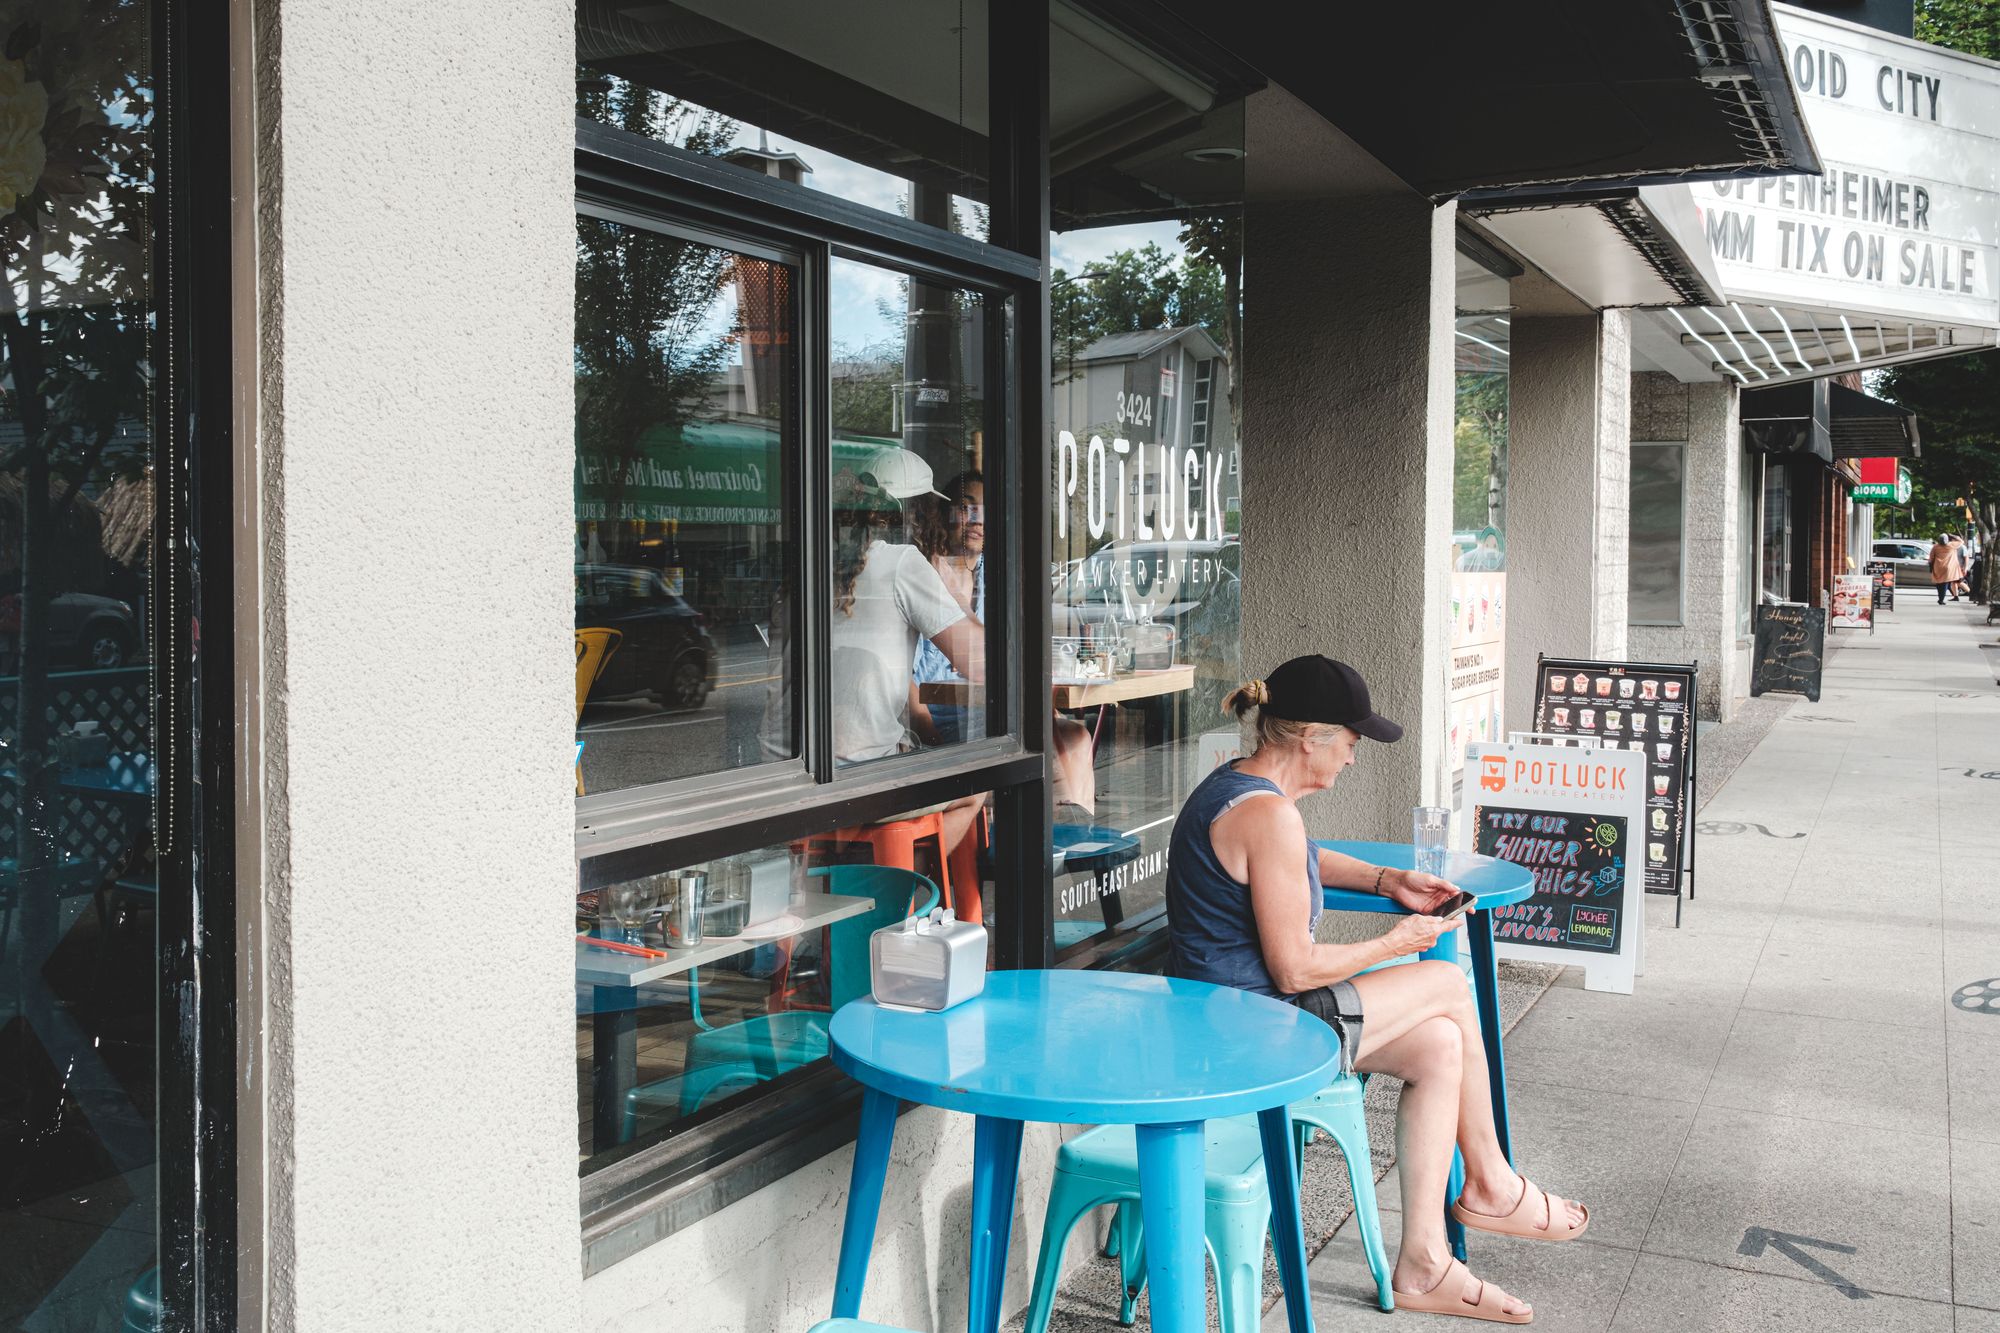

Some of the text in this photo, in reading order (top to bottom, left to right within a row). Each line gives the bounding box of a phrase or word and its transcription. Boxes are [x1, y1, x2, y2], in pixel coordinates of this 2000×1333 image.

[1784, 43, 1941, 121] OID CITY
[1777, 220, 1831, 274] TIX
[1843, 230, 1885, 282] ON
[1900, 239, 1975, 294] SALE
[1116, 391, 1152, 427] 3424
[1058, 430, 1223, 541] POTLUCK
[1853, 486, 1889, 495] SIOPAO
[1059, 559, 1223, 588] HAWKER EATERY
[1514, 760, 1627, 791] POTLUCK
[1514, 786, 1625, 801] HAWKER EATERY
[1488, 813, 1570, 835] TRY OUR
[1060, 864, 1128, 914] SOUTH-EAST
[1132, 850, 1161, 884] ASIAN
[1495, 904, 1553, 926] ODAY'S
[1492, 920, 1567, 942] LAVOUR:
